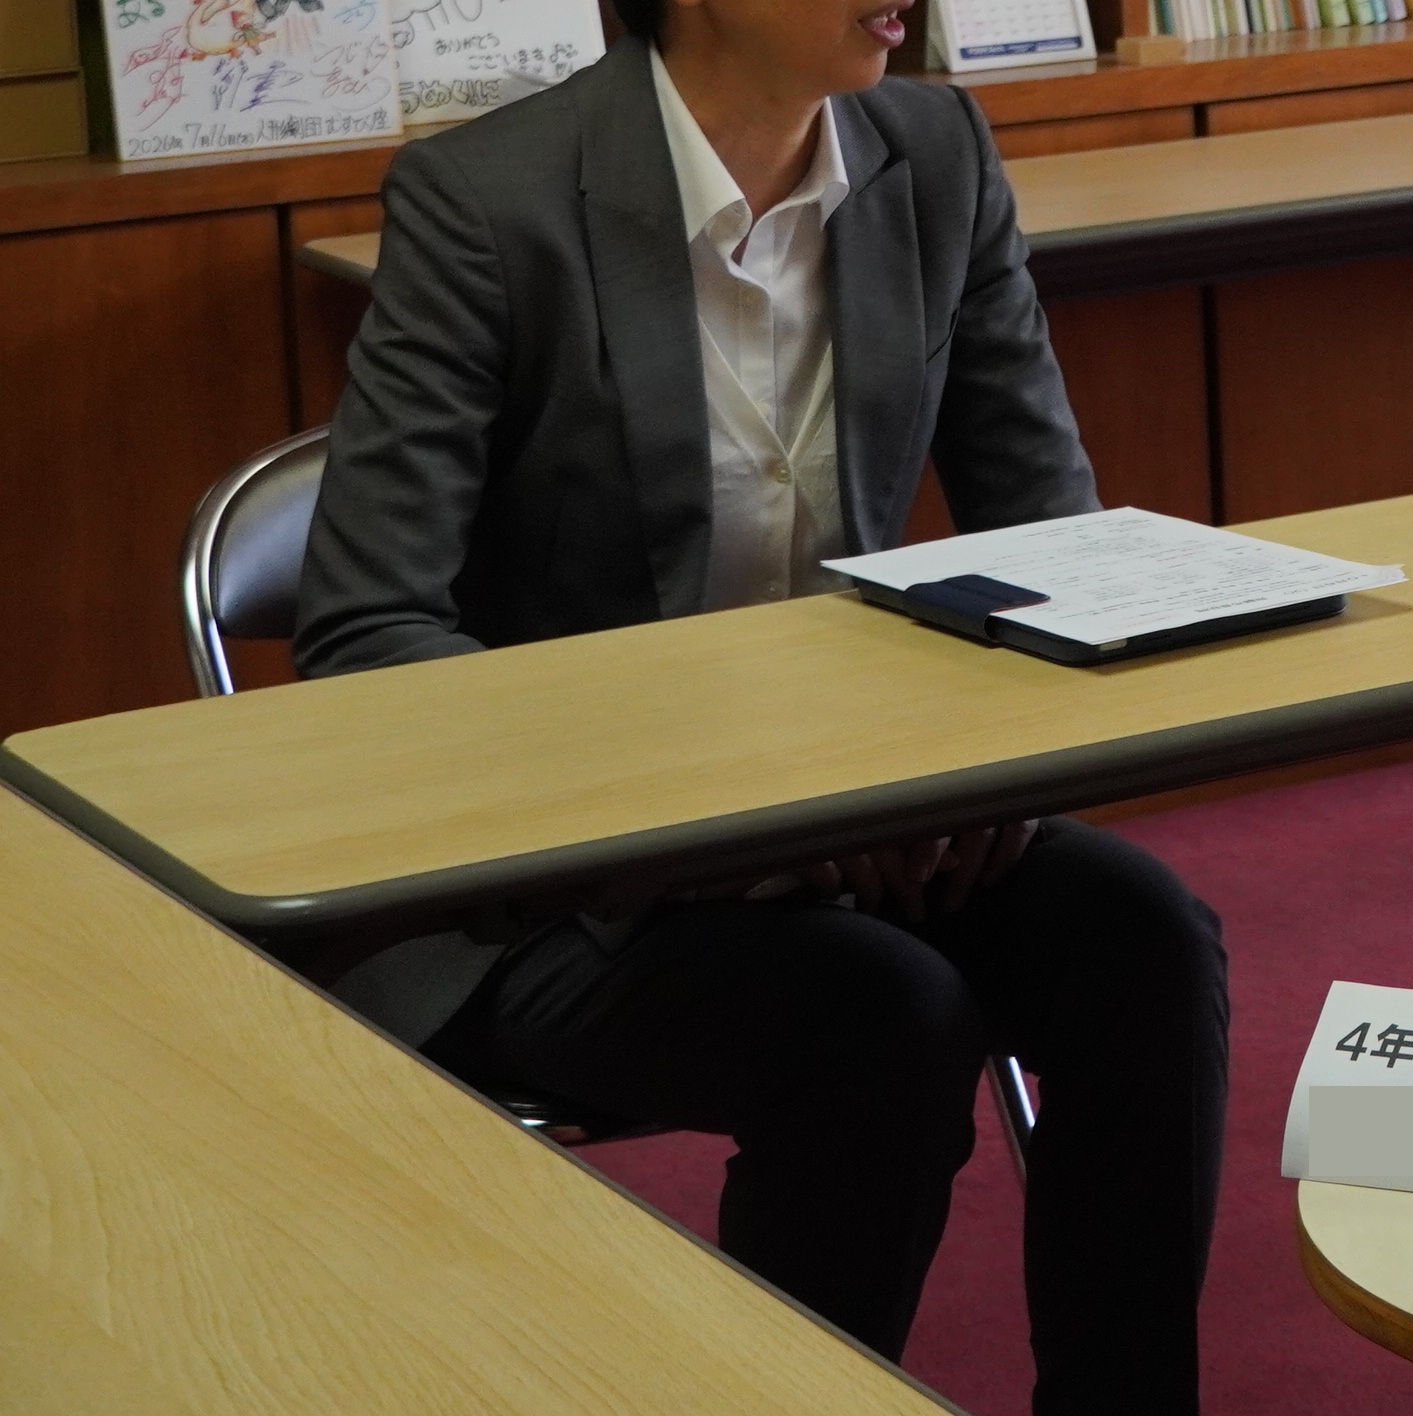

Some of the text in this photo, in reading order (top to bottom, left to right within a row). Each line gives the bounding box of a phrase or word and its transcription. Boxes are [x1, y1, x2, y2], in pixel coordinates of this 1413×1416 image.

[436, 33, 500, 56] ありがとう
[252, 106, 392, 143] 人形劇団むすび座
